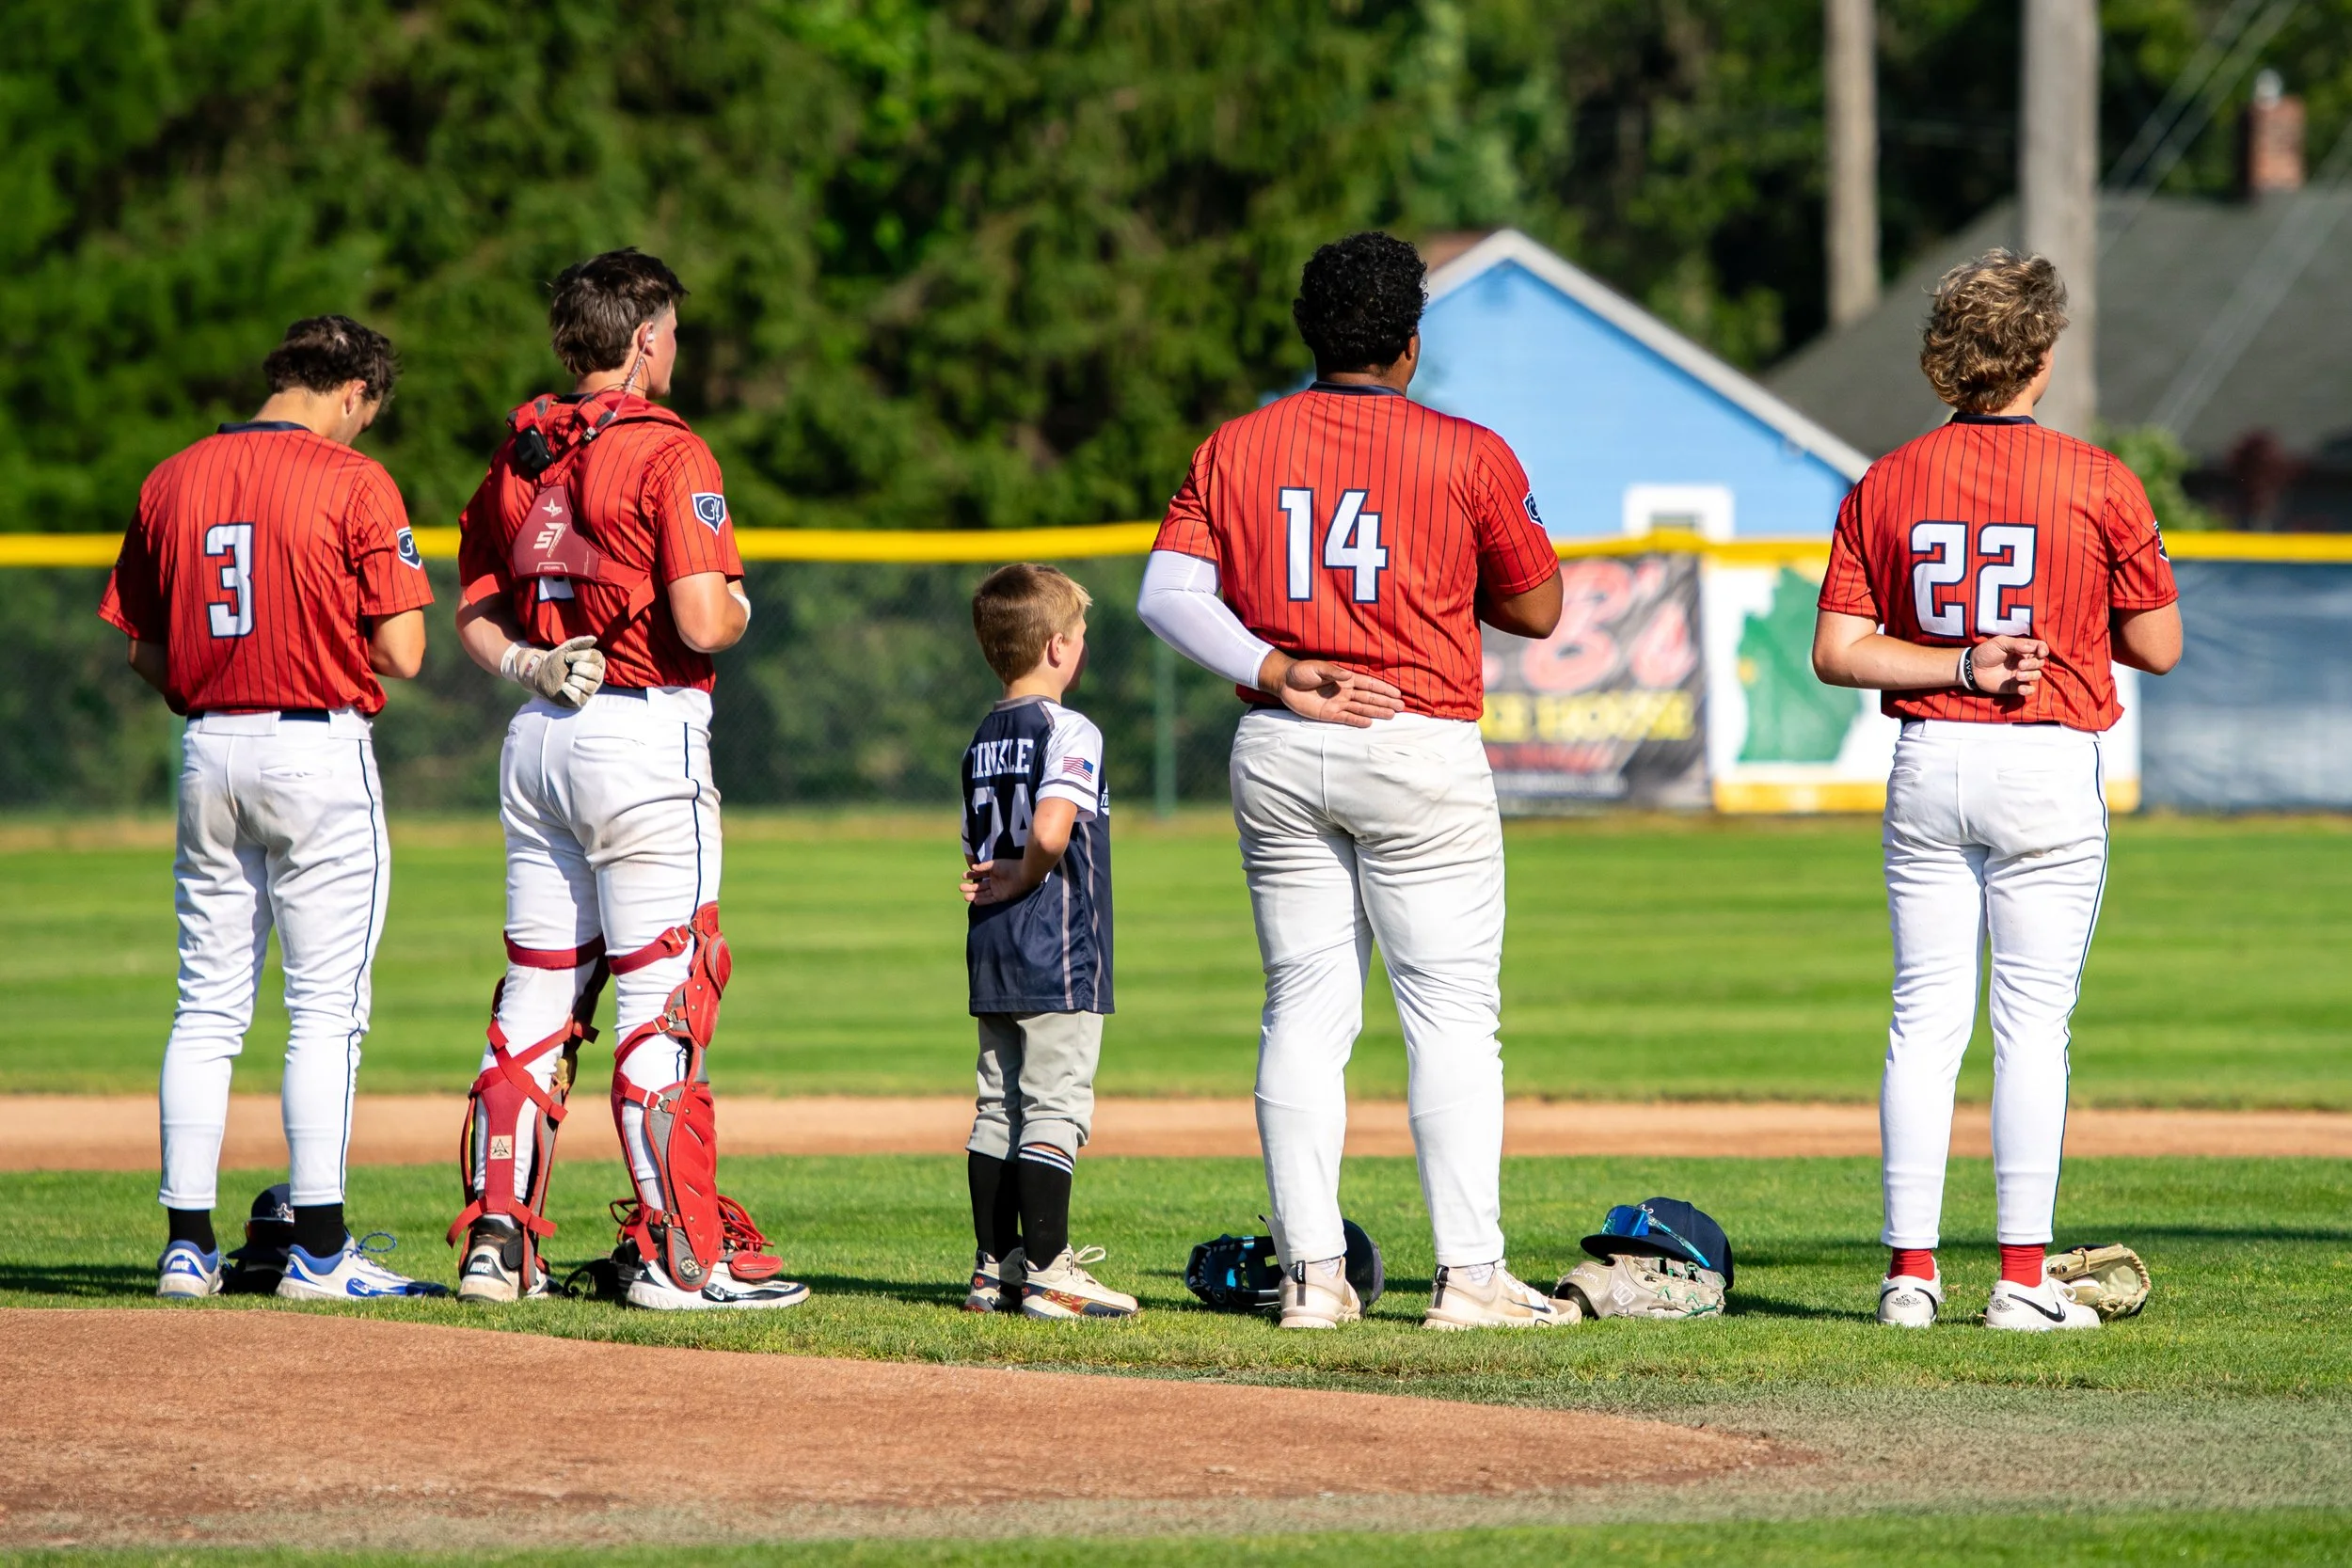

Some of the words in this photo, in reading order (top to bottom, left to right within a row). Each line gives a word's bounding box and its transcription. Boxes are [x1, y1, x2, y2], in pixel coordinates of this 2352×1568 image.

[204, 522, 255, 639] 3
[1278, 486, 1390, 603] 14
[1909, 520, 2038, 640] 22
[170, 1260, 191, 1271] NIKE
[469, 1261, 493, 1274] NIKE
